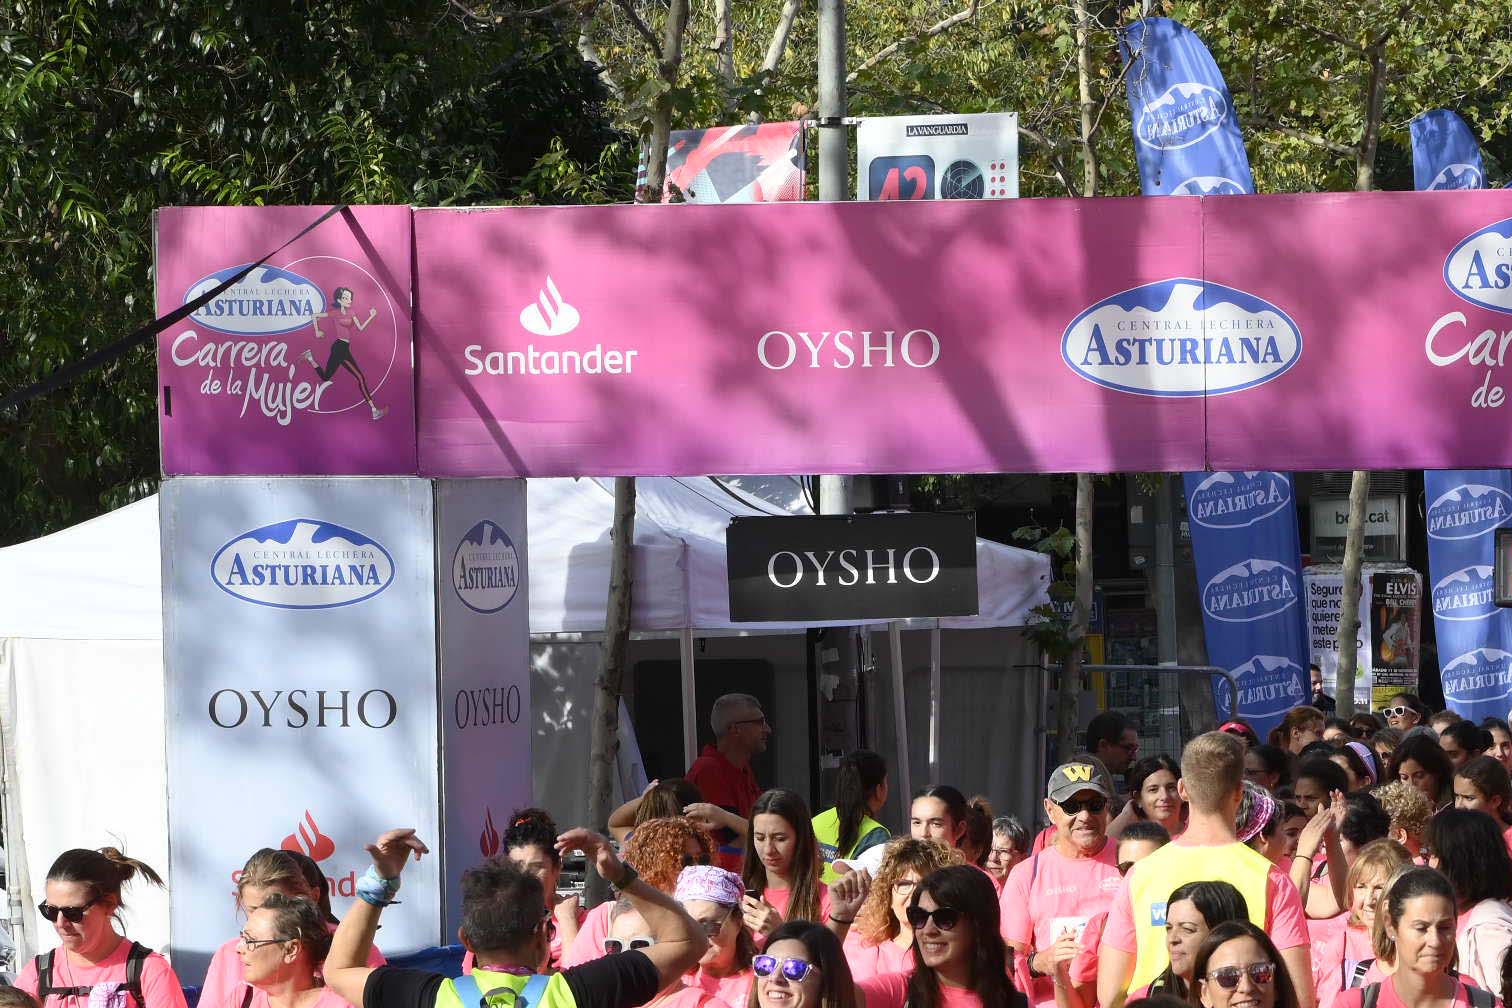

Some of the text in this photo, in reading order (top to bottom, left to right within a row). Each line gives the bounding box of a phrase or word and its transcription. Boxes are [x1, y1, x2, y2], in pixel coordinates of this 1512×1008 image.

[223, 288, 262, 296] ENTRAL
[1117, 318, 1276, 331] CENTRAL LECHERA
[171, 330, 289, 368] Carrera
[464, 344, 638, 377] Santander
[757, 329, 940, 370] OYSHO
[1080, 323, 1284, 366] ASTURIANA
[199, 363, 334, 426] de la Mujer
[1470, 369, 1506, 408] de
[225, 553, 381, 587] ASTURIANA
[253, 549, 375, 560] CENTRAL LECHERA
[767, 546, 941, 588] OYSHO
[458, 555, 516, 590] ASTURIANA
[1386, 582, 1416, 595] ELVIS
[1311, 598, 1328, 611] que
[1311, 610, 1344, 622] quiere
[1313, 638, 1332, 649] este
[208, 689, 398, 729] OYSHO
[455, 684, 521, 731] OYSHO
[1062, 765, 1094, 782] W
